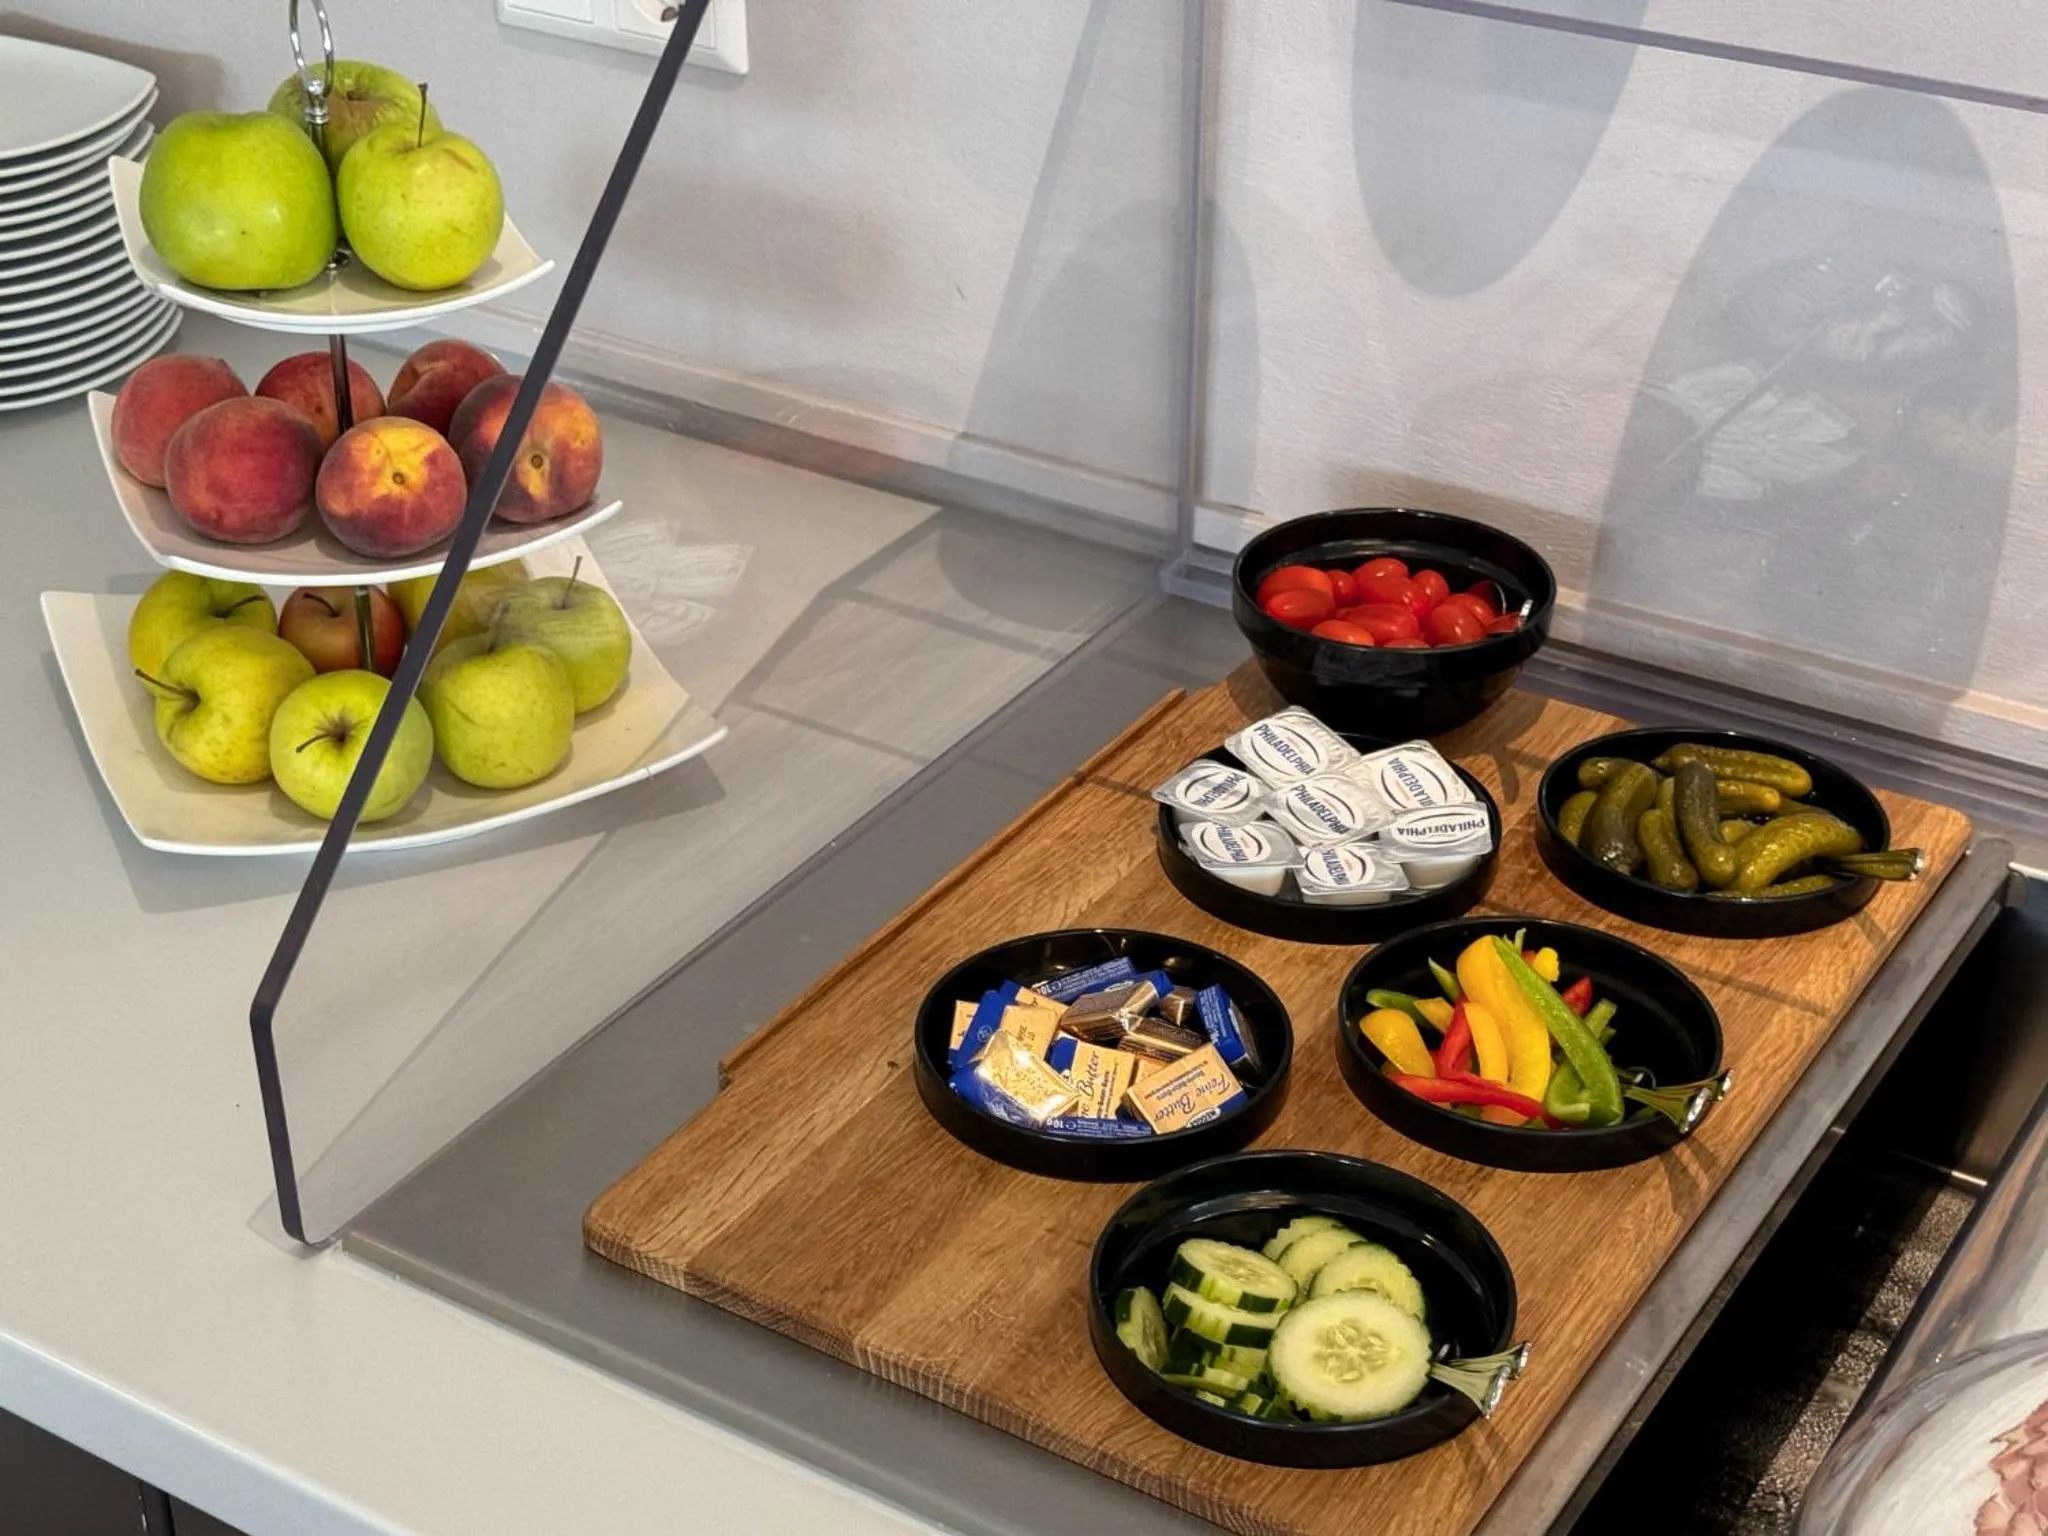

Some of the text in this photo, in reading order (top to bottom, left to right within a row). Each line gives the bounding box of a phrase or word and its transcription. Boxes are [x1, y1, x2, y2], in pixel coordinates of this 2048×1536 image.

[1254, 723, 1317, 775] PHILADELPHIA
[1289, 784, 1351, 835] PHILADELPHIA
[1397, 818, 1486, 837] PHILADELPHIA
[1076, 1050, 1100, 1098] Butter
[1196, 1073, 1231, 1096] Feine
[1154, 1092, 1196, 1122] Butter
